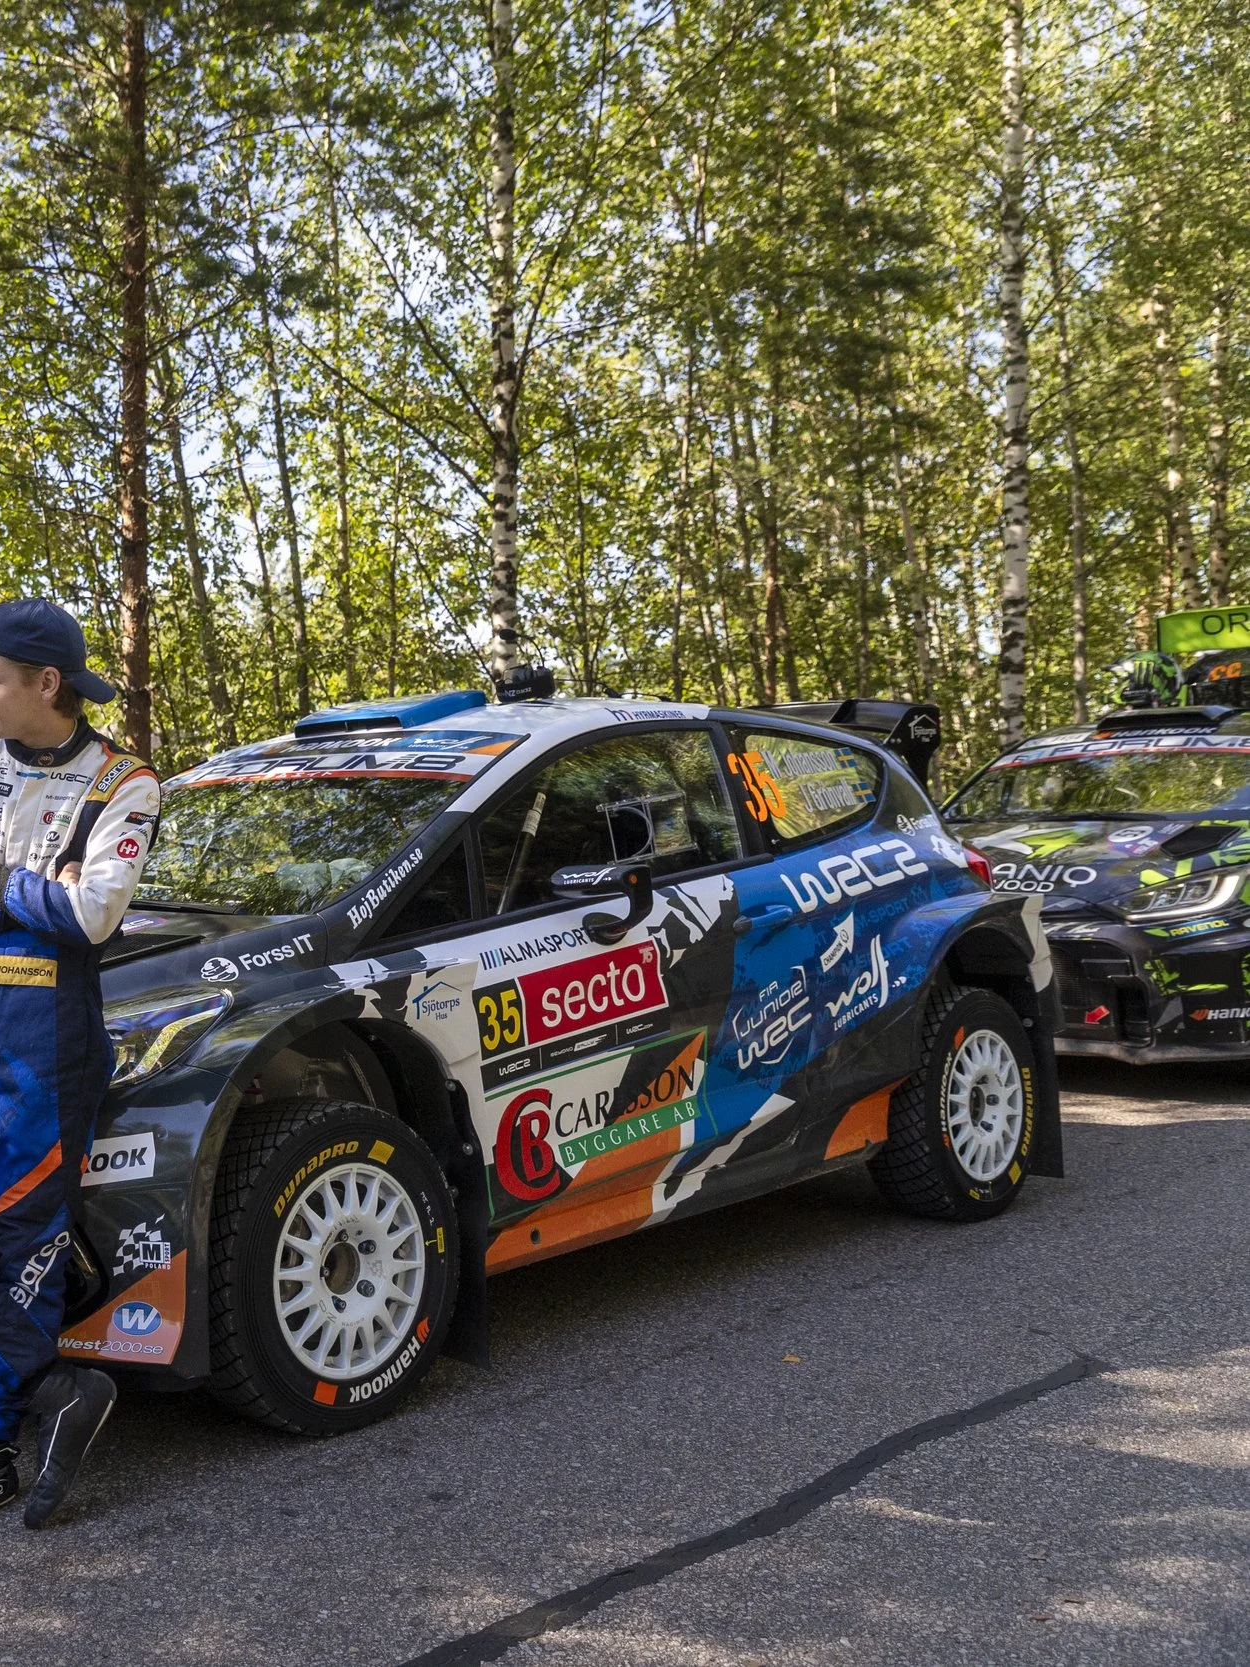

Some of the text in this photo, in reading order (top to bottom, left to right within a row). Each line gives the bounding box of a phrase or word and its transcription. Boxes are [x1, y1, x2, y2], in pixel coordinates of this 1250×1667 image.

[782, 748, 838, 777] Johansson
[726, 751, 787, 823] 35
[346, 847, 424, 930] HojButiken.se
[781, 839, 928, 913] WRC2
[1169, 919, 1230, 937] RAVENOL
[239, 933, 315, 972] Forss IT
[823, 943, 844, 967] CHAMPION
[421, 996, 461, 1017] Sjötorps
[541, 960, 646, 1029] secto
[740, 980, 804, 1038] JUNIOR
[759, 980, 779, 1003] FIA
[435, 1011, 448, 1021] Hus
[479, 989, 522, 1051] 35
[833, 992, 879, 1032] LUBRICANTS
[737, 996, 813, 1070] WRC
[499, 1058, 532, 1076] WRC2
[564, 1101, 696, 1164] BYGGARE AB
[57, 1337, 164, 1355] West2000.se
